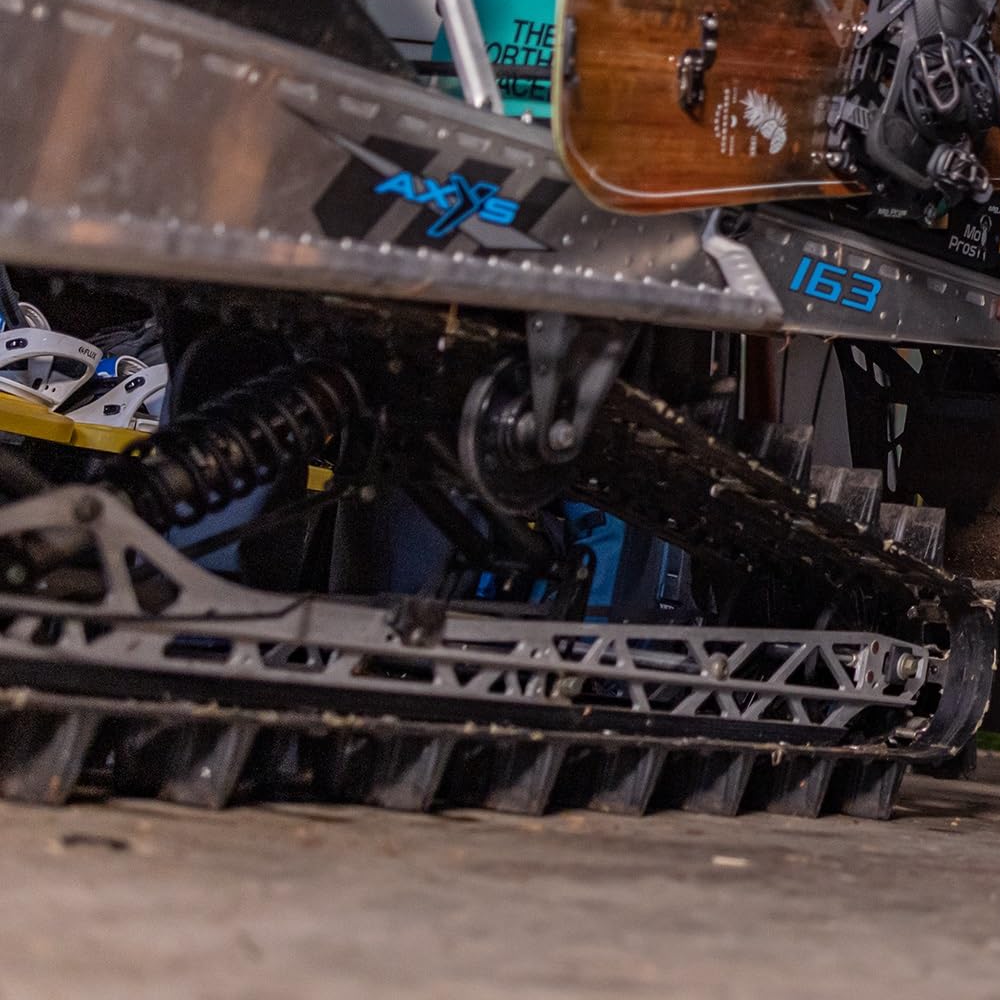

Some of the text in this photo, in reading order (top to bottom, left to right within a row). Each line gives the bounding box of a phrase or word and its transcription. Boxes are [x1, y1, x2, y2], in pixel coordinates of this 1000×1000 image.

[513, 18, 556, 48] THE
[486, 41, 553, 68] ORTH
[496, 75, 546, 101] ACE
[963, 223, 981, 242] Mo
[948, 235, 978, 258] Pros
[788, 255, 884, 313] 163
